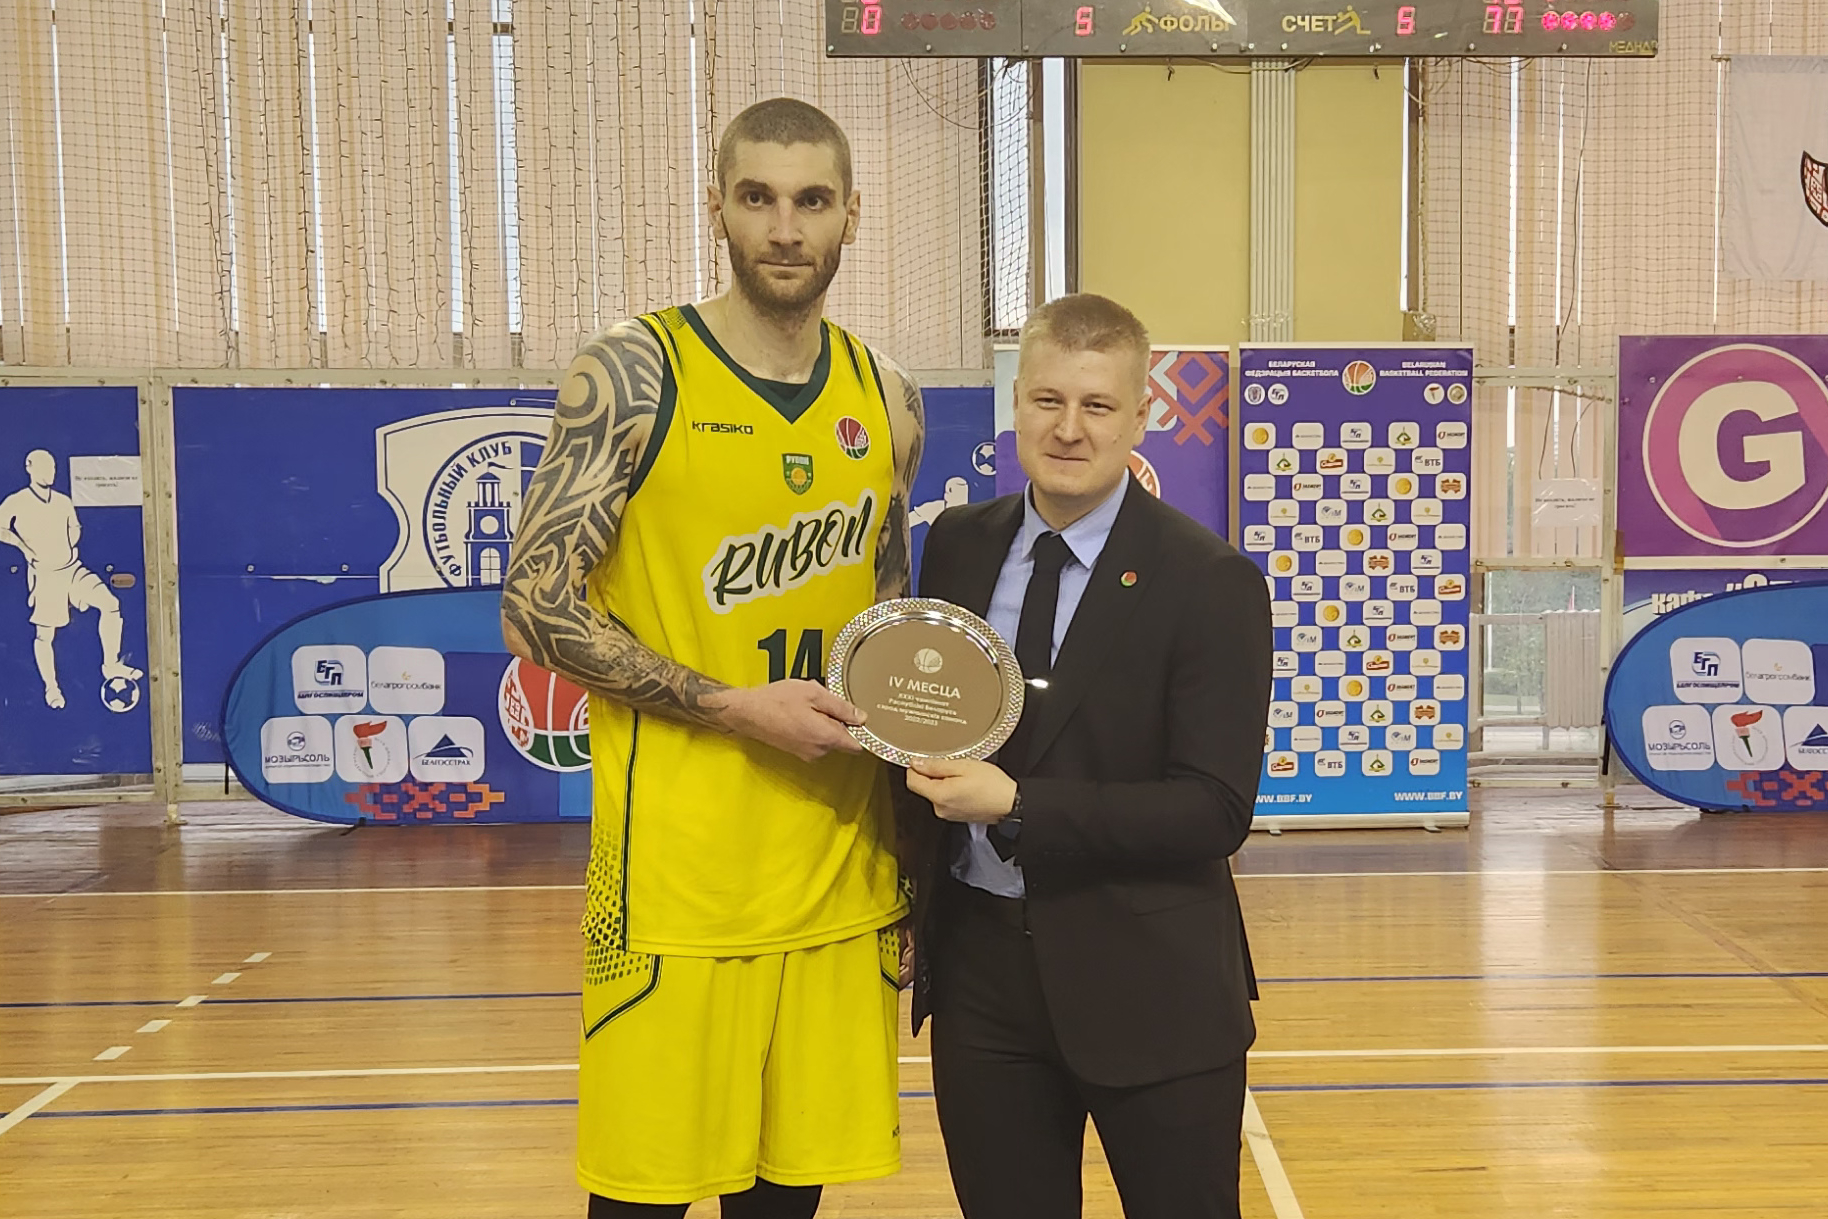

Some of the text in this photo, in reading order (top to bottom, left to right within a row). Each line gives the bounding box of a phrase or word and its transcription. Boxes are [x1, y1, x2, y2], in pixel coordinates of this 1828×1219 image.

[1282, 15, 1337, 33] СЧЕТ
[1678, 381, 1806, 510] G
[432, 441, 513, 577] ФУТБОЛЬНЫЙ КЛУБ
[757, 628, 826, 684] 14
[889, 676, 961, 699] IV МЕСЦА
[1327, 761, 1343, 769] ВТБ
